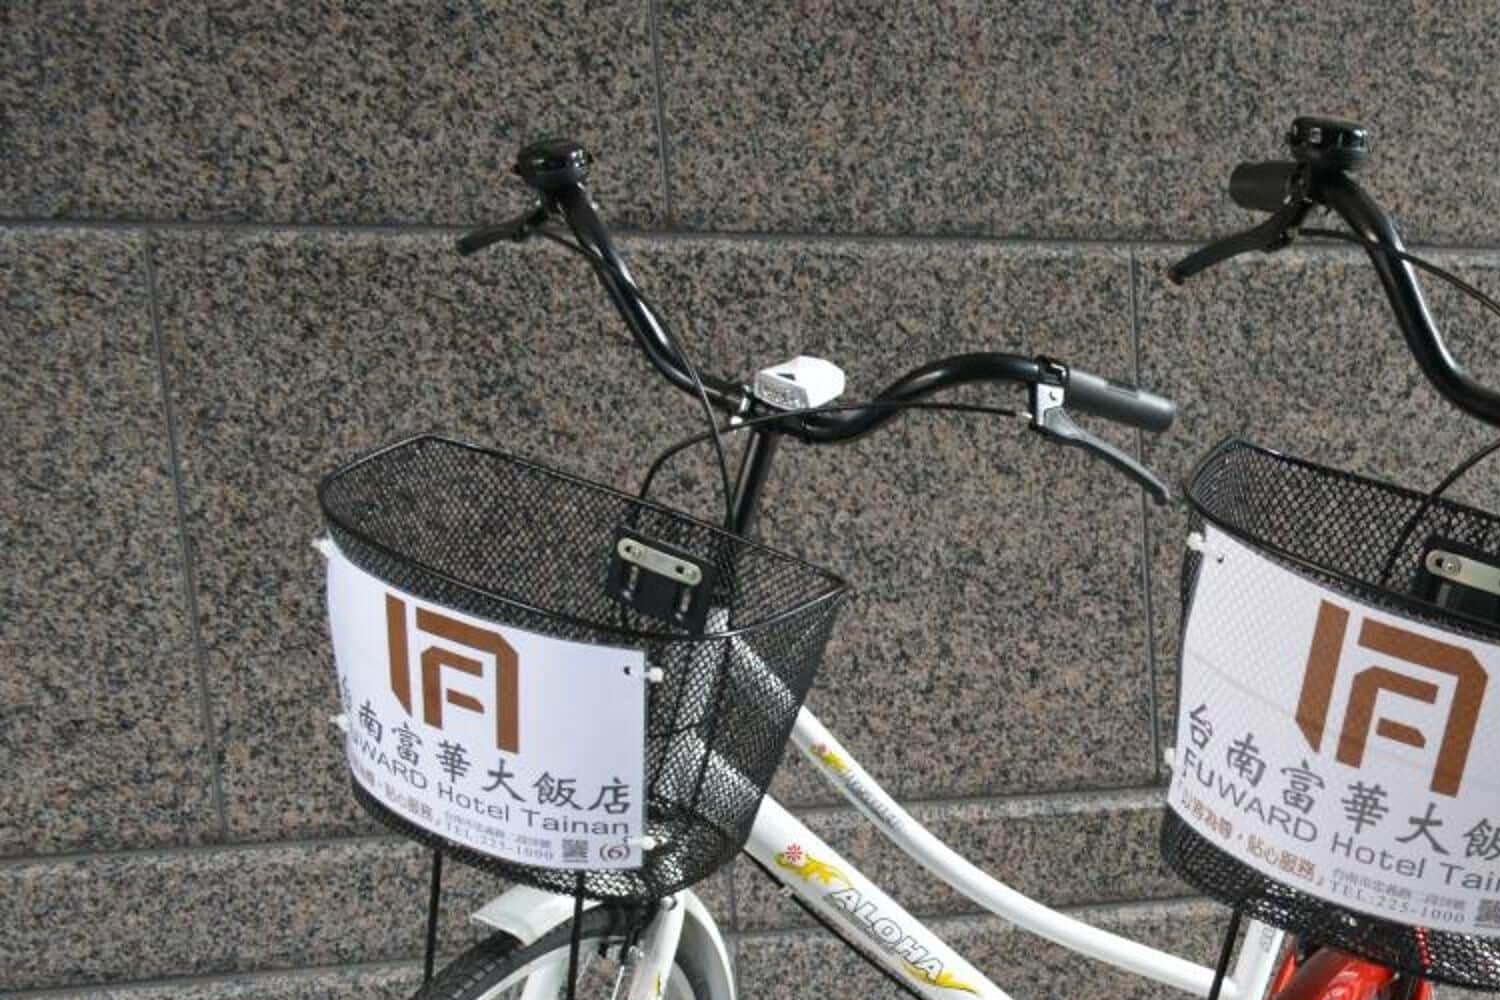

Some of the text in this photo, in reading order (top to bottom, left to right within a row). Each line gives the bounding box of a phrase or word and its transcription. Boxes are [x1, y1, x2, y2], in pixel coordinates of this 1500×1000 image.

[437, 781, 510, 822] Hotel
[520, 807, 630, 835] Tainan
[1183, 747, 1318, 843] FUWARD
[1331, 831, 1426, 879] Hotel
[829, 887, 944, 980] ALOHA
